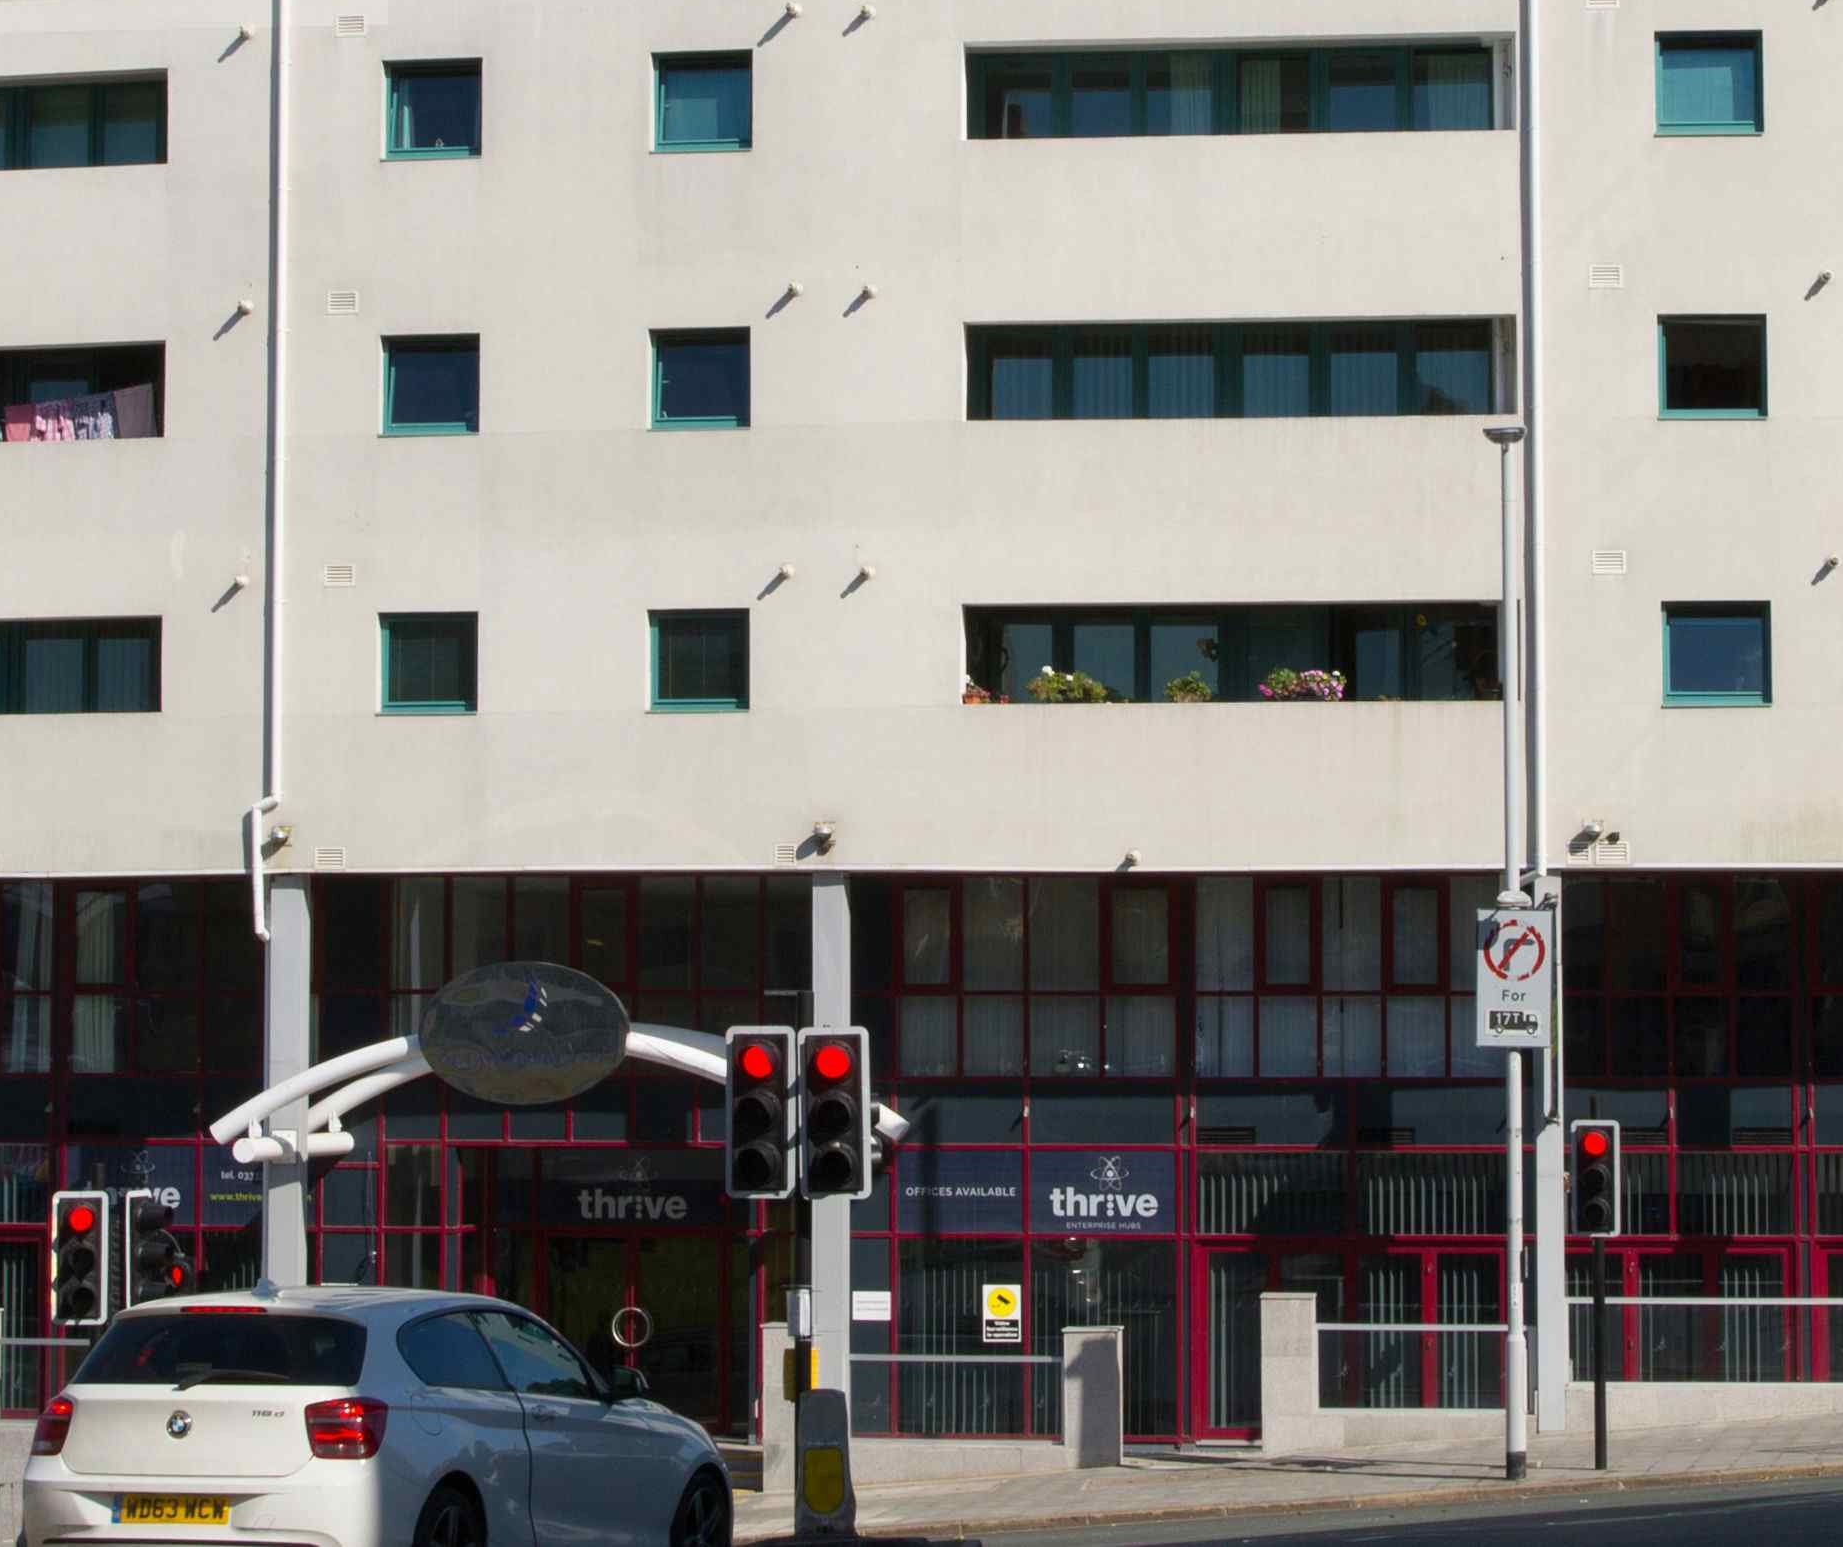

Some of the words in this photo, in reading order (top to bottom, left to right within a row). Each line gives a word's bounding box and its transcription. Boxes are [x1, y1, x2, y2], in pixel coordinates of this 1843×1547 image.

[1501, 989, 1526, 1002] For
[1497, 1012, 1520, 1025] 17T
[905, 1186, 953, 1197] OFFICES
[955, 1186, 1016, 1197] AVAILABLE
[577, 1188, 688, 1220] thrive
[1049, 1186, 1159, 1218] thrive
[1066, 1221, 1116, 1230] ENTERPRISE
[1118, 1221, 1142, 1230] HUBS
[126, 1497, 179, 1519] WD63
[184, 1497, 225, 1519] WCW
